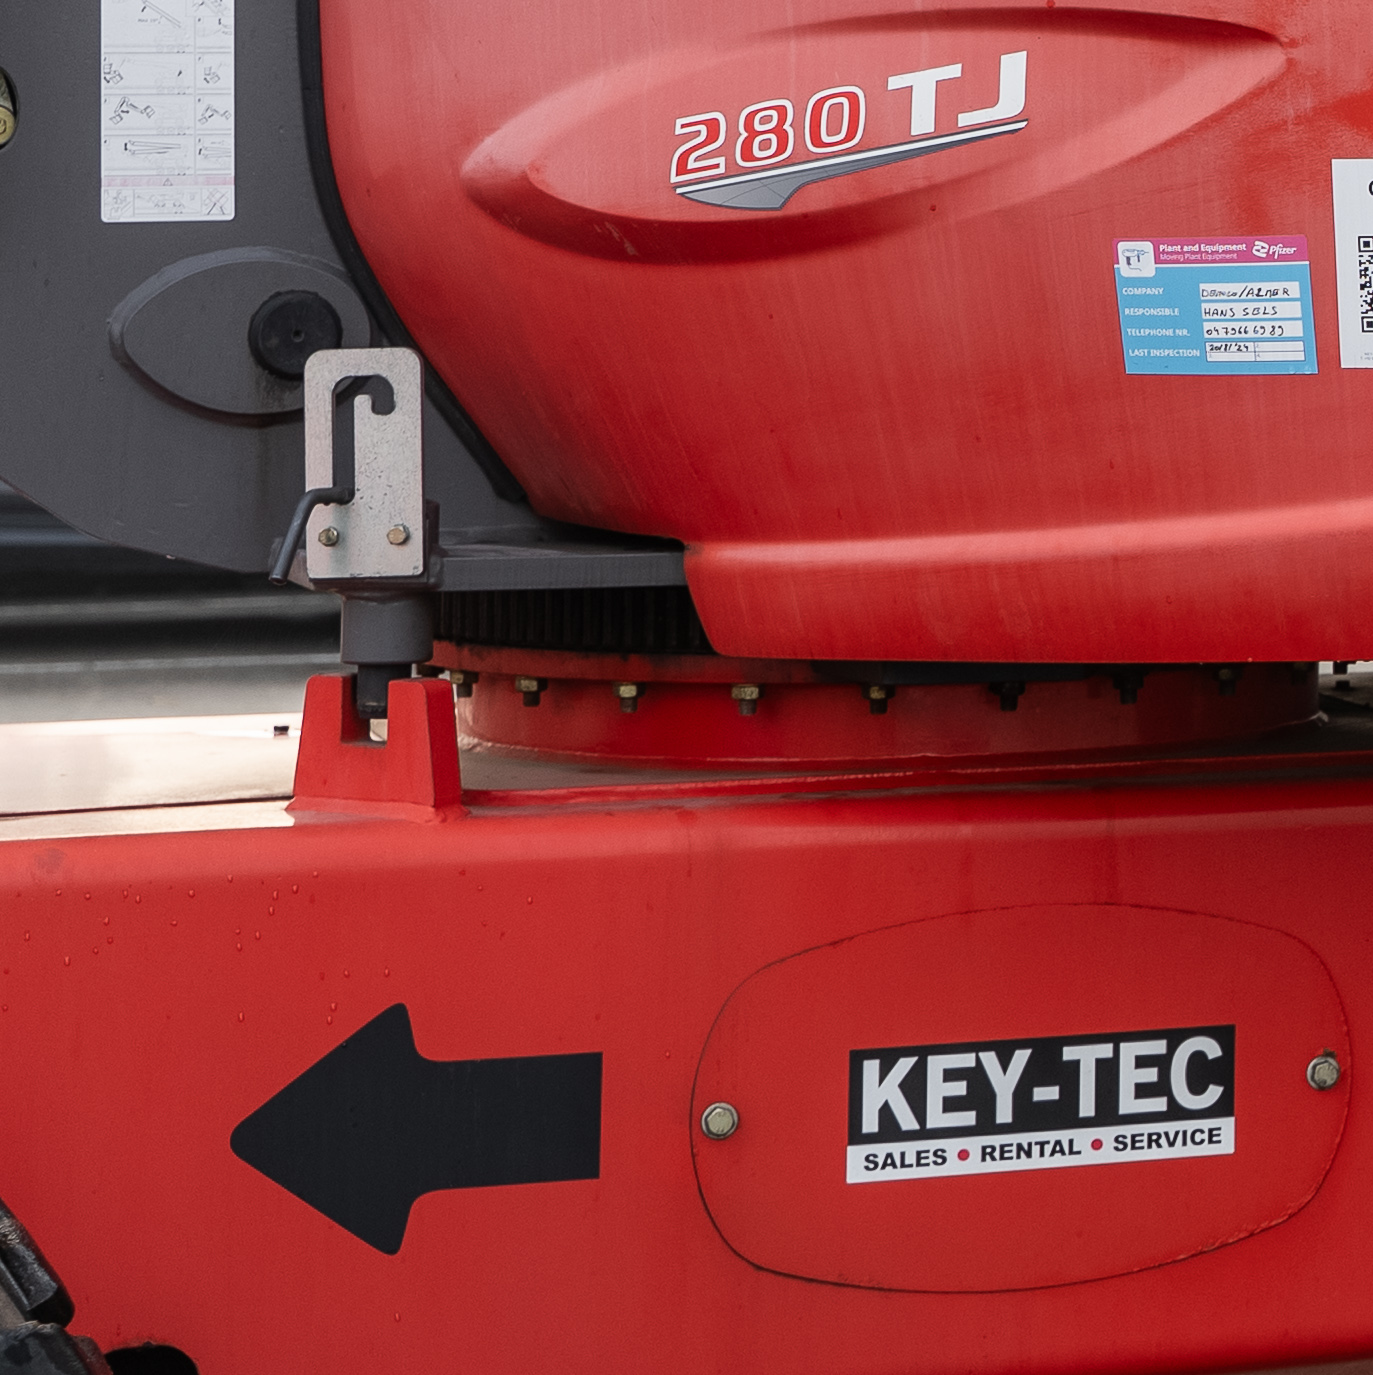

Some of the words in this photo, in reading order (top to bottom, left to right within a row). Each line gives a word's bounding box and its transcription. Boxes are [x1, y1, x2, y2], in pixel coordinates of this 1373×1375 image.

[670, 85, 866, 184] 280
[887, 50, 1028, 136] TJ
[1159, 243, 1181, 252] Plant
[1183, 243, 1199, 252] and
[1200, 243, 1247, 254] Equipment
[1269, 243, 1298, 260] Pfizer
[1122, 287, 1164, 296] COMPANY
[1124, 308, 1180, 316] RESPONSIBLE
[1204, 307, 1235, 318] HANS
[1127, 328, 1174, 337] TELEPHONE
[1129, 349, 1149, 357] LAST
[1150, 348, 1200, 357] INSPECTION
[861, 1036, 1225, 1134] KEY-TEC
[863, 1147, 948, 1172] SALES
[980, 1138, 1082, 1163] RENTAL
[1113, 1126, 1223, 1152] SERVICE
